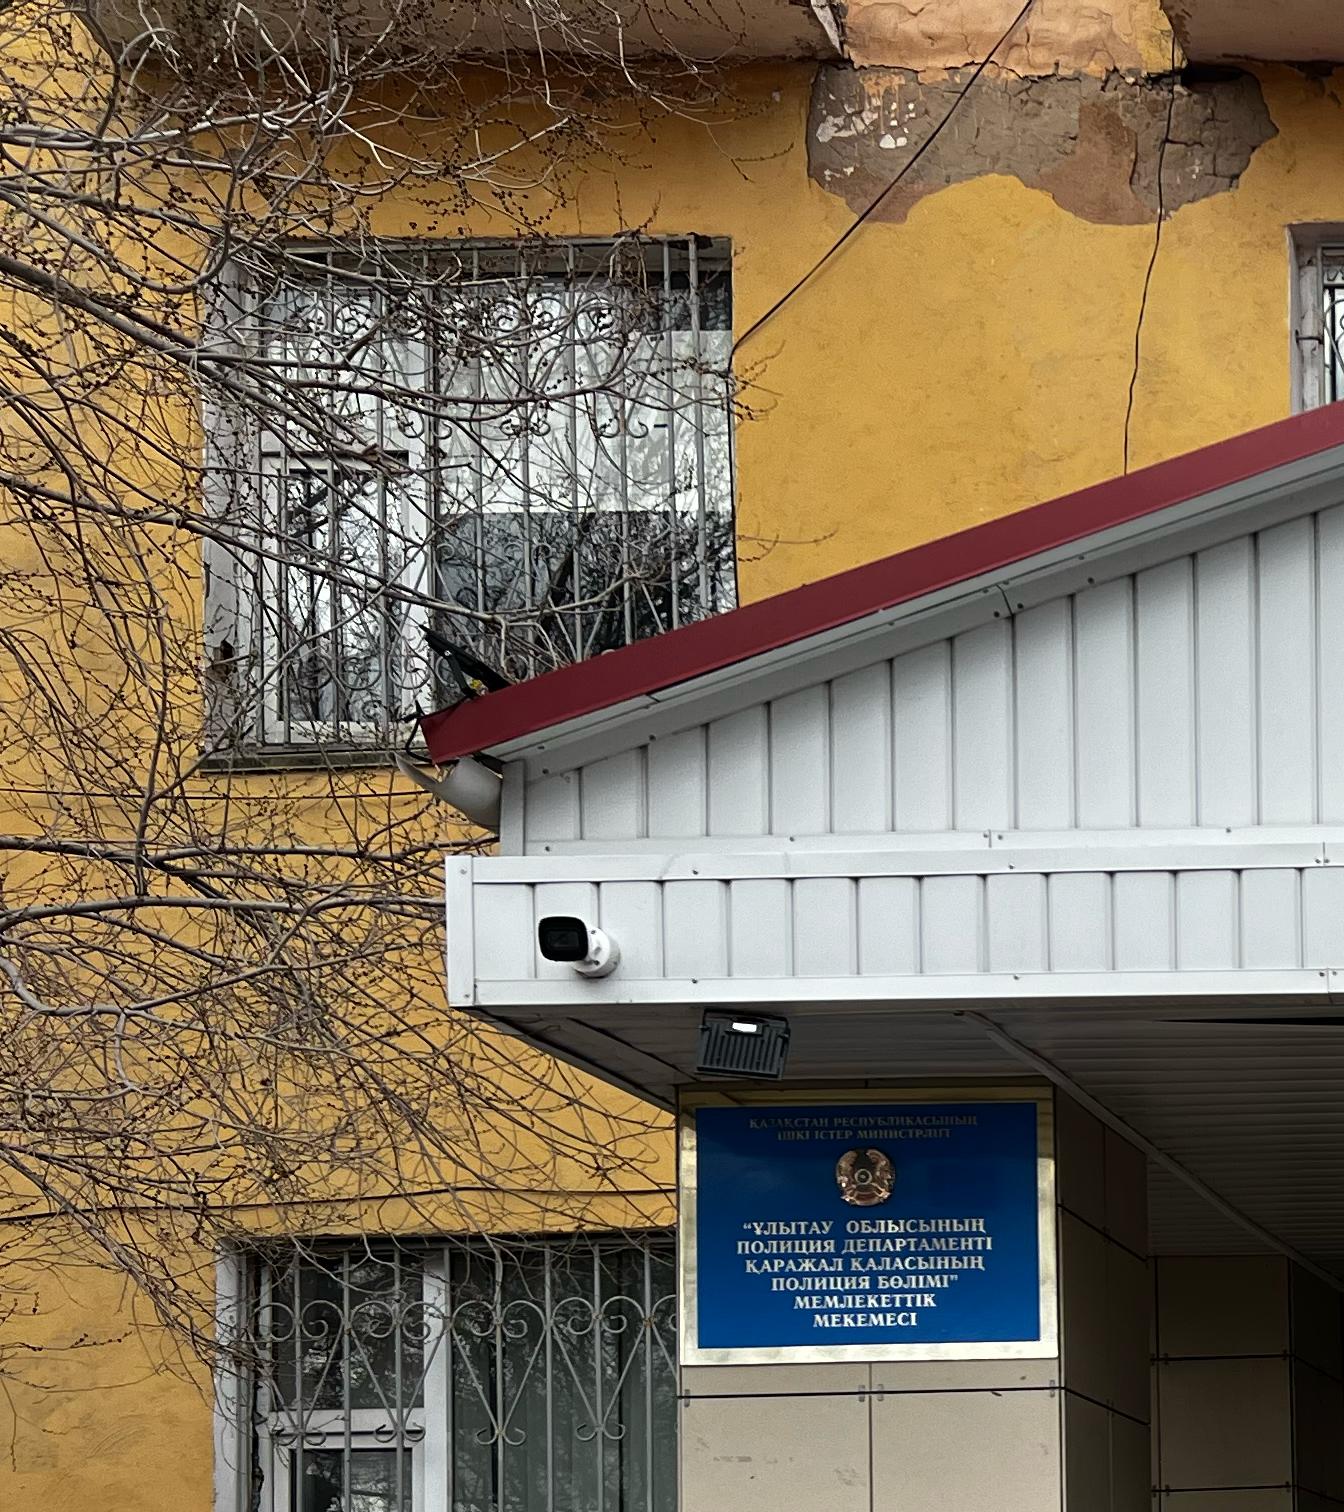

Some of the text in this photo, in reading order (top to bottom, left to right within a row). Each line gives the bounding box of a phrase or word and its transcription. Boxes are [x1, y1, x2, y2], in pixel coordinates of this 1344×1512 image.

[846, 1218, 985, 1234] ОБЛЫСЫНЫҢ
[736, 1237, 993, 1256] ПОЛИЦИЯ ДЕПАРТАМЕНТІ
[745, 1256, 985, 1275] ҚАРАЖАЛ ҚАЛАСЫНЫҢ
[771, 1276, 869, 1292] ПОЛИЦИЯ
[794, 1294, 936, 1309] МЕМЛЕКЕТТІК
[813, 1312, 917, 1327] МЕКЕМЕСІ
